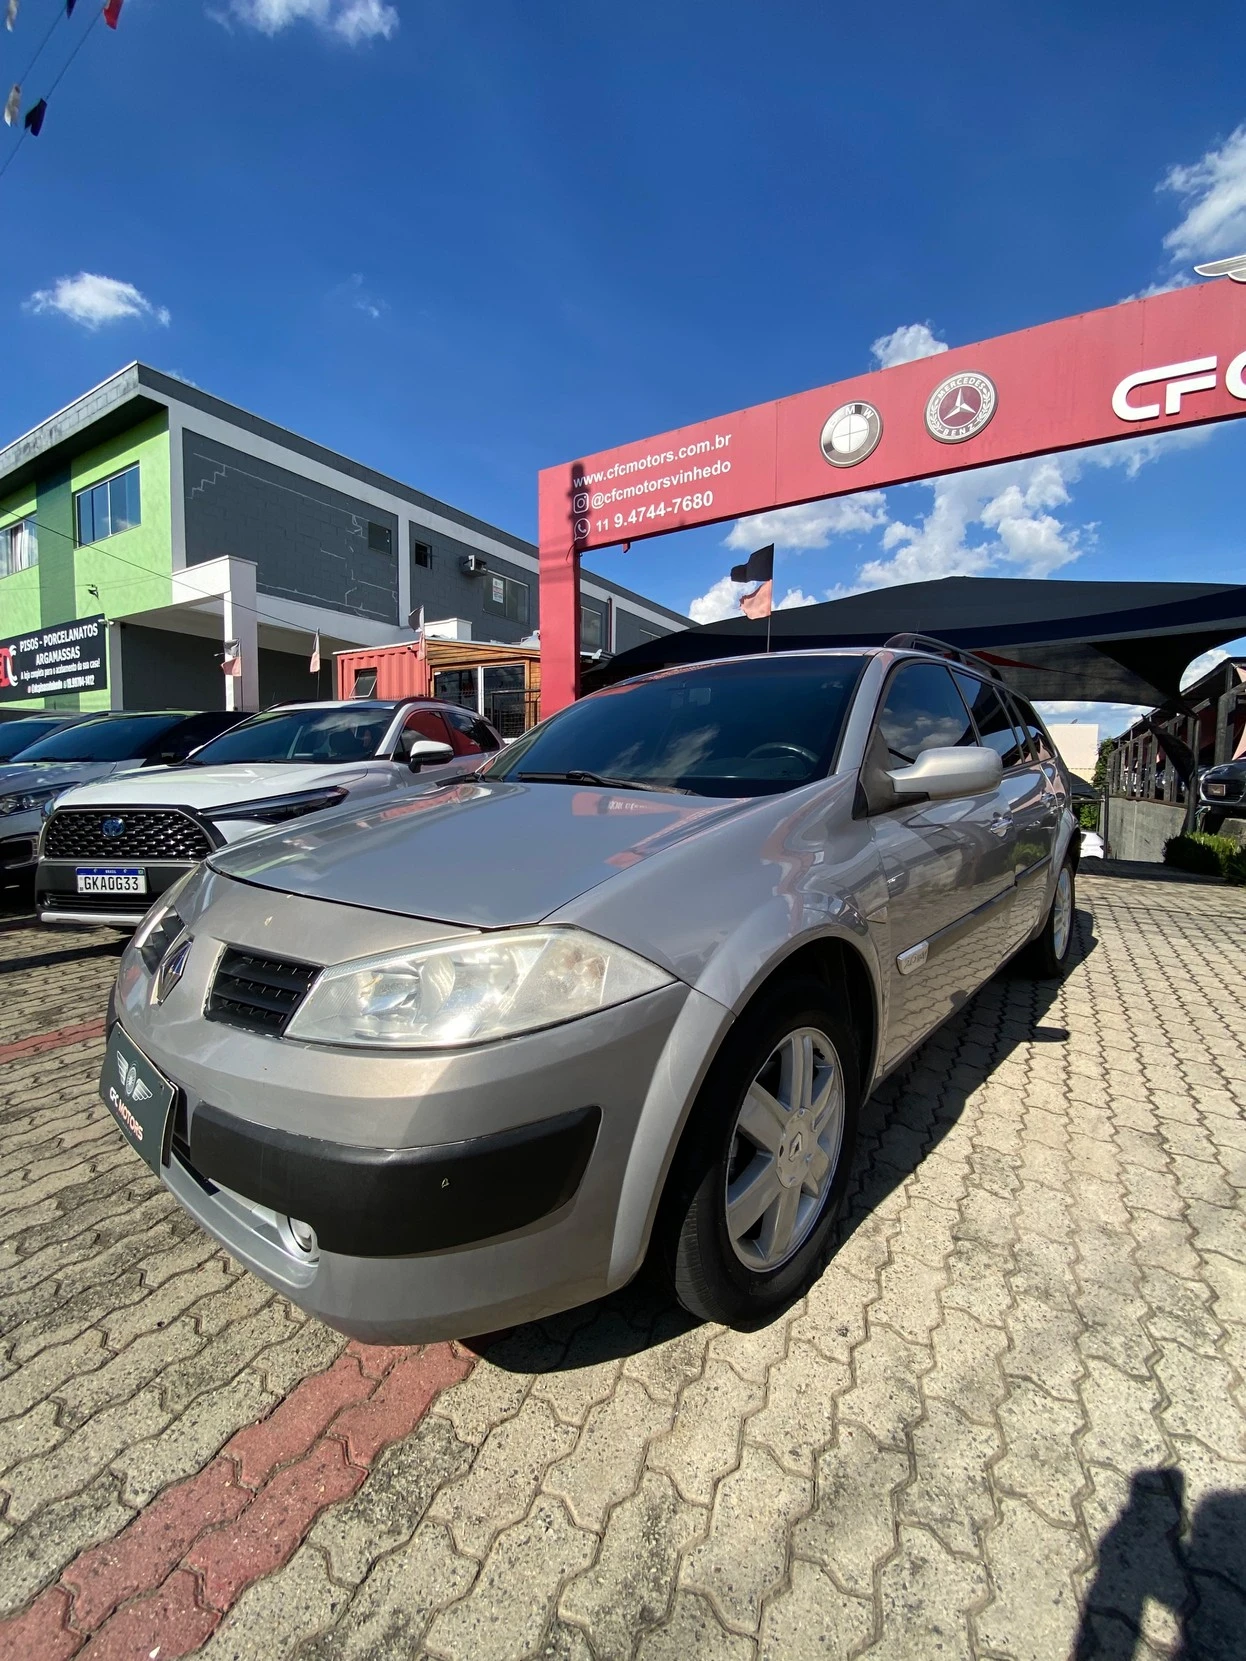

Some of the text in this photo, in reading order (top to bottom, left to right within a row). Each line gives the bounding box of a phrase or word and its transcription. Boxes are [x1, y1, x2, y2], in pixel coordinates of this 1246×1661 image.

[937, 377, 986, 399] MERCEDES
[1112, 351, 1246, 421] CF
[943, 423, 976, 436] BENZ
[573, 434, 731, 488] www.cfcmotors.com.br
[591, 460, 731, 510] @cfcmotorsvinhedo
[596, 491, 713, 532] 11 9.4744-7680
[20, 637, 39, 653] PISOS
[43, 623, 98, 647] PORCELANATOS
[36, 646, 81, 666] ARGAMASSAS
[118, 1099, 143, 1141] MOTORS
